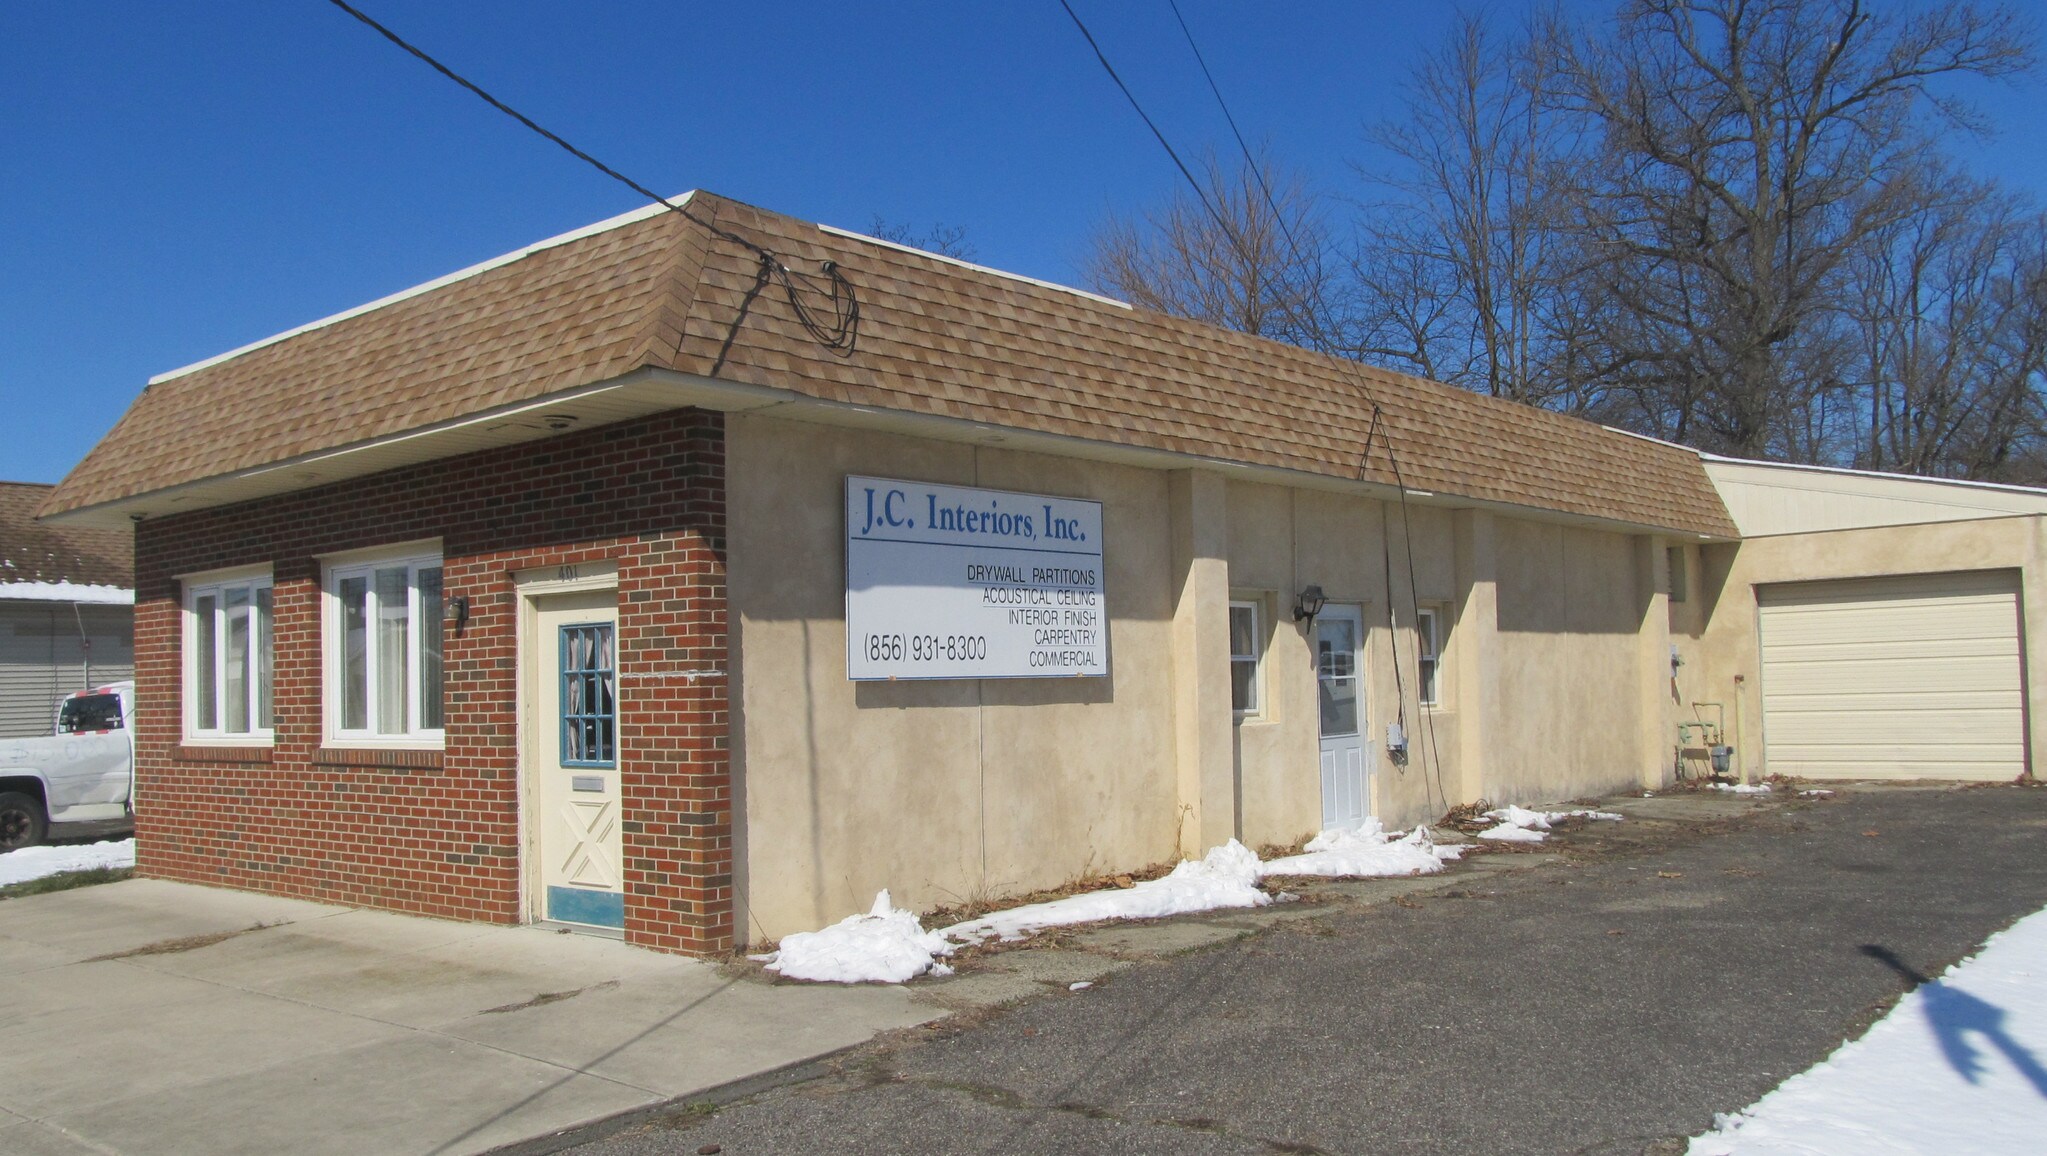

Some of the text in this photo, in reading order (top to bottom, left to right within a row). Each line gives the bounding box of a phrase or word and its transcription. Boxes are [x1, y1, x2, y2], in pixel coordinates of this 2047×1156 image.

[862, 487, 1086, 542] J.C. Interiors, Inc.
[559, 564, 578, 582] 401
[967, 564, 1096, 586] DRYWALL PARTITIONS
[982, 587, 1096, 606] ACOUSTICAL CEILING
[1008, 609, 1097, 627] INTERIOR FINISH
[1034, 629, 1097, 646] CARPENTRY
[864, 633, 987, 663] (856) 931-8300
[1029, 650, 1098, 668] COMMERCIAL
